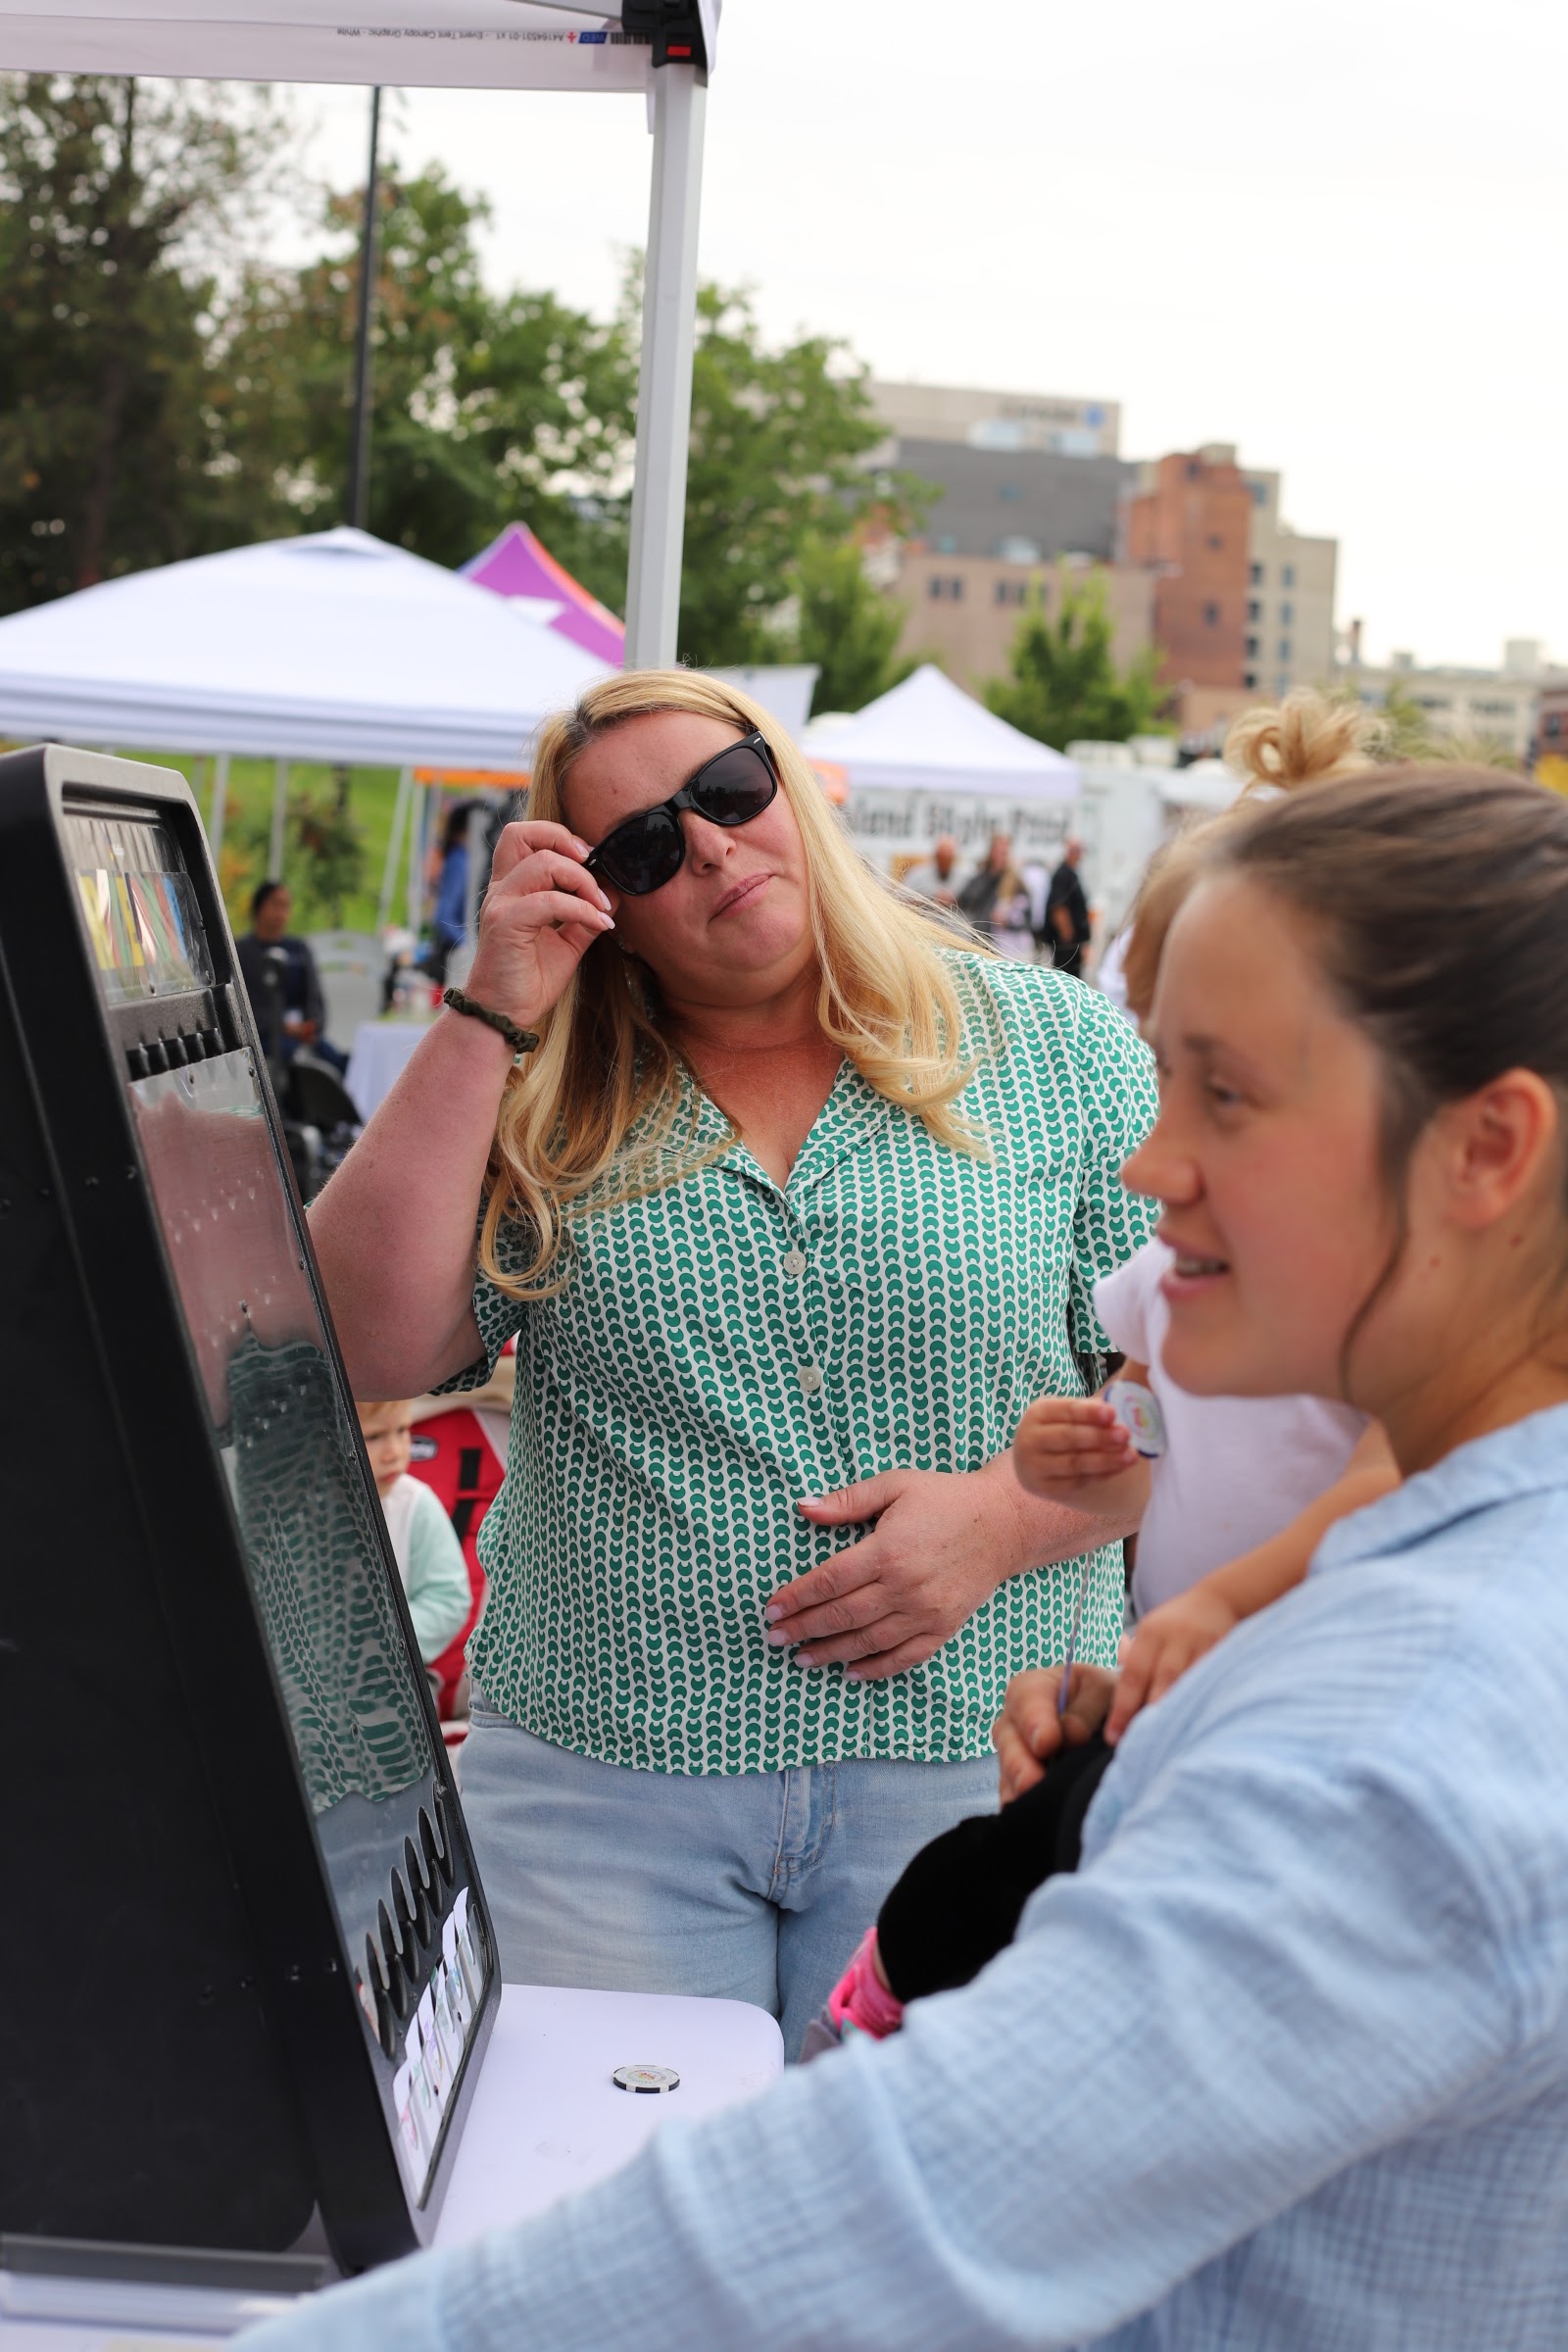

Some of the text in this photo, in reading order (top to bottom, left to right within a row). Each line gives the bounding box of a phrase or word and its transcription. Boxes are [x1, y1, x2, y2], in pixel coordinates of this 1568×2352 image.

[337, 27, 361, 37] White
[368, 28, 402, 38] Graphic
[403, 29, 437, 39] Canopy
[438, 30, 458, 40] Tent
[459, 31, 483, 40] Event
